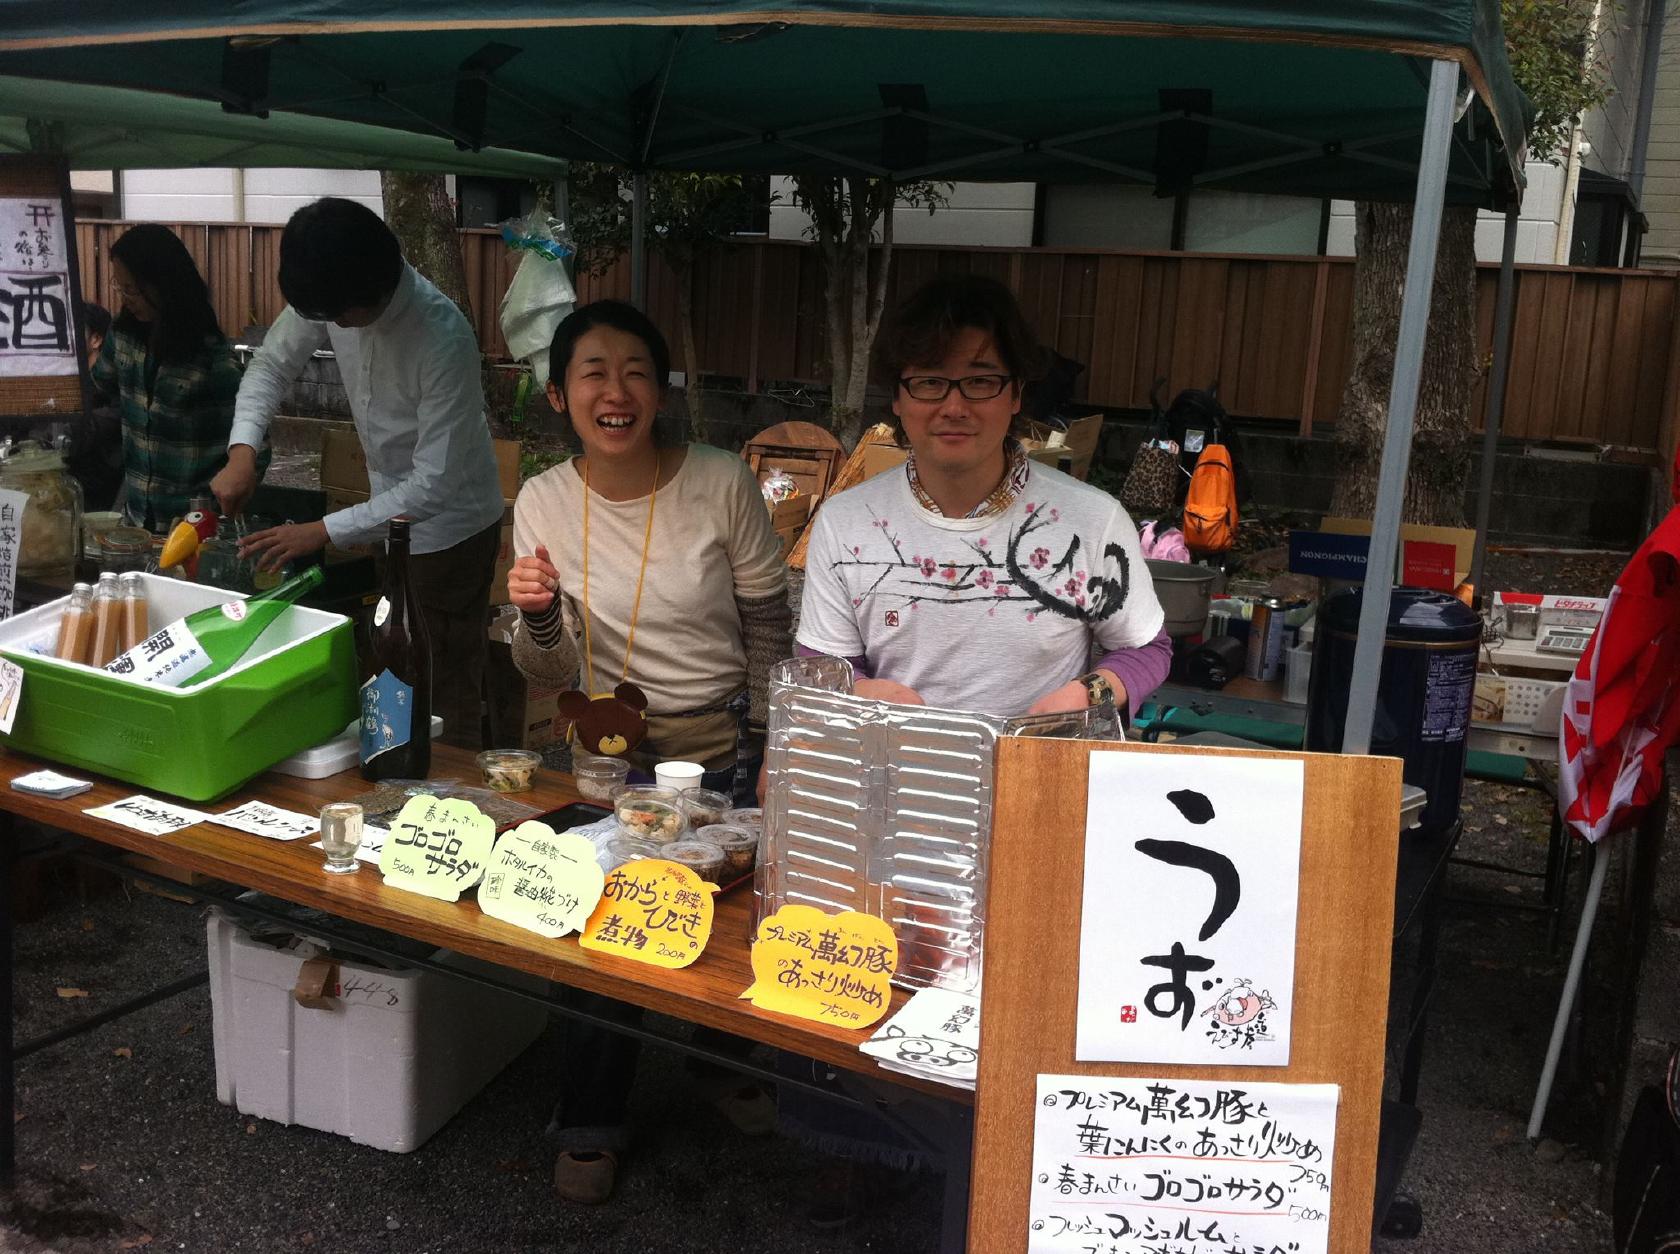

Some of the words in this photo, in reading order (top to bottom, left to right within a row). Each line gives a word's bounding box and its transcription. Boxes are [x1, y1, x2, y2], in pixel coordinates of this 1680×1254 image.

[394, 823, 463, 856] ゴロゴロ
[425, 852, 480, 882] サラダ
[1133, 788, 1242, 1032] うず
[820, 1001, 861, 1021] 750円
